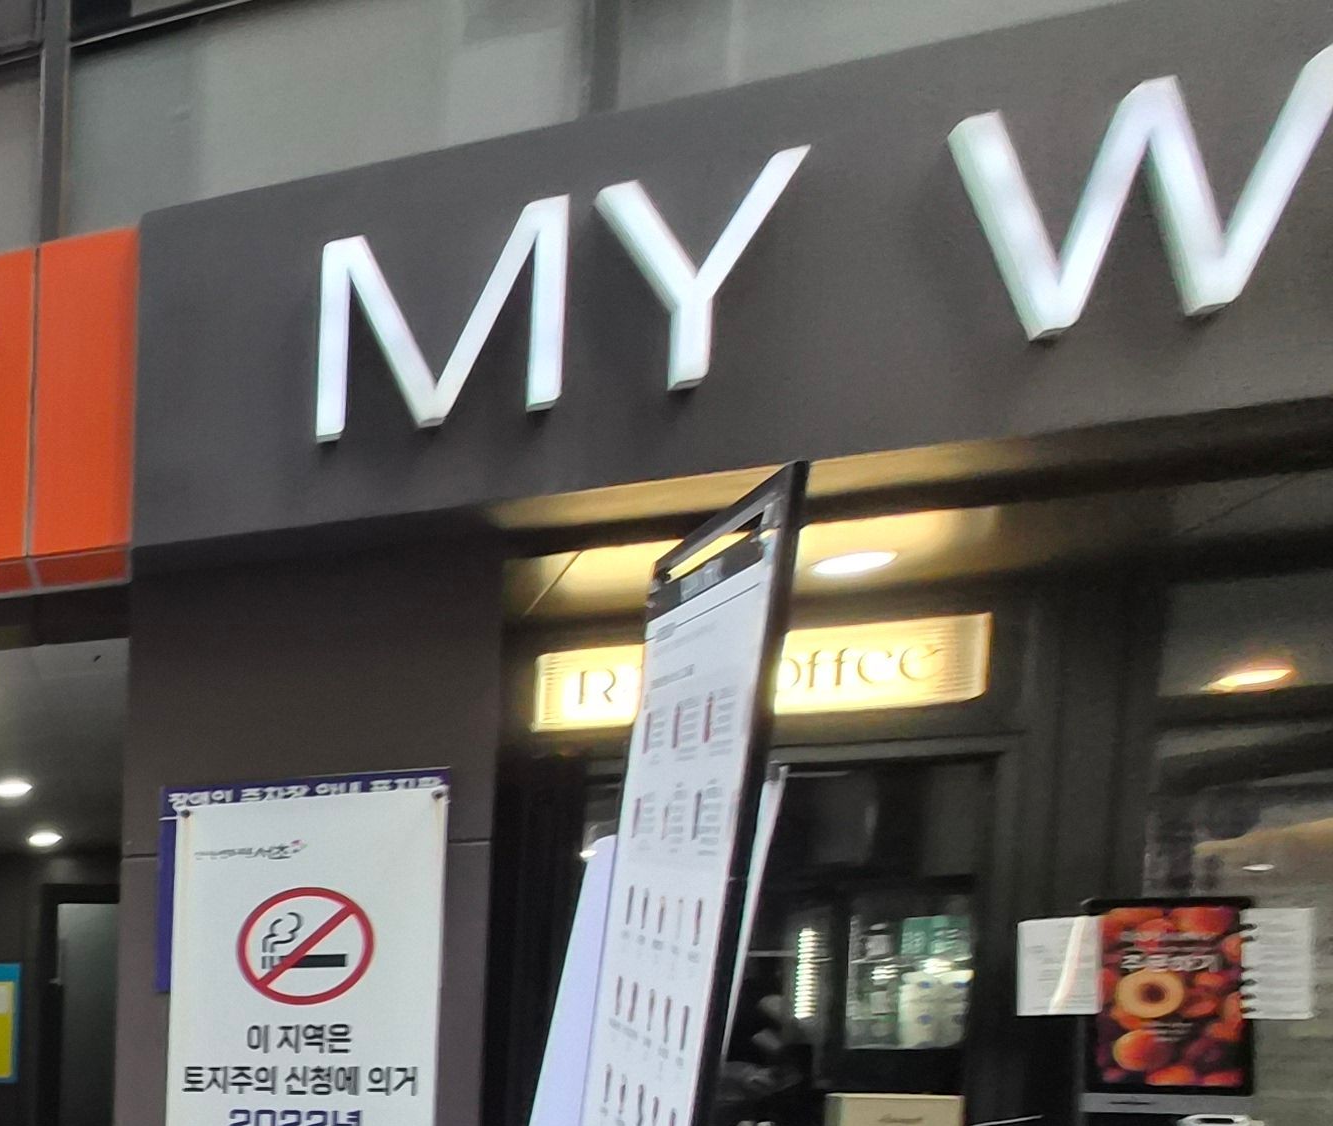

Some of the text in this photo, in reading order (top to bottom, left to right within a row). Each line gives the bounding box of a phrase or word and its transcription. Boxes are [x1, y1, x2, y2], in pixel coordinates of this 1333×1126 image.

[314, 143, 811, 442] MY
[782, 646, 944, 688] offee
[246, 1023, 352, 1054] 이 지역은
[182, 1065, 420, 1096] 토지주의 신청에 의거
